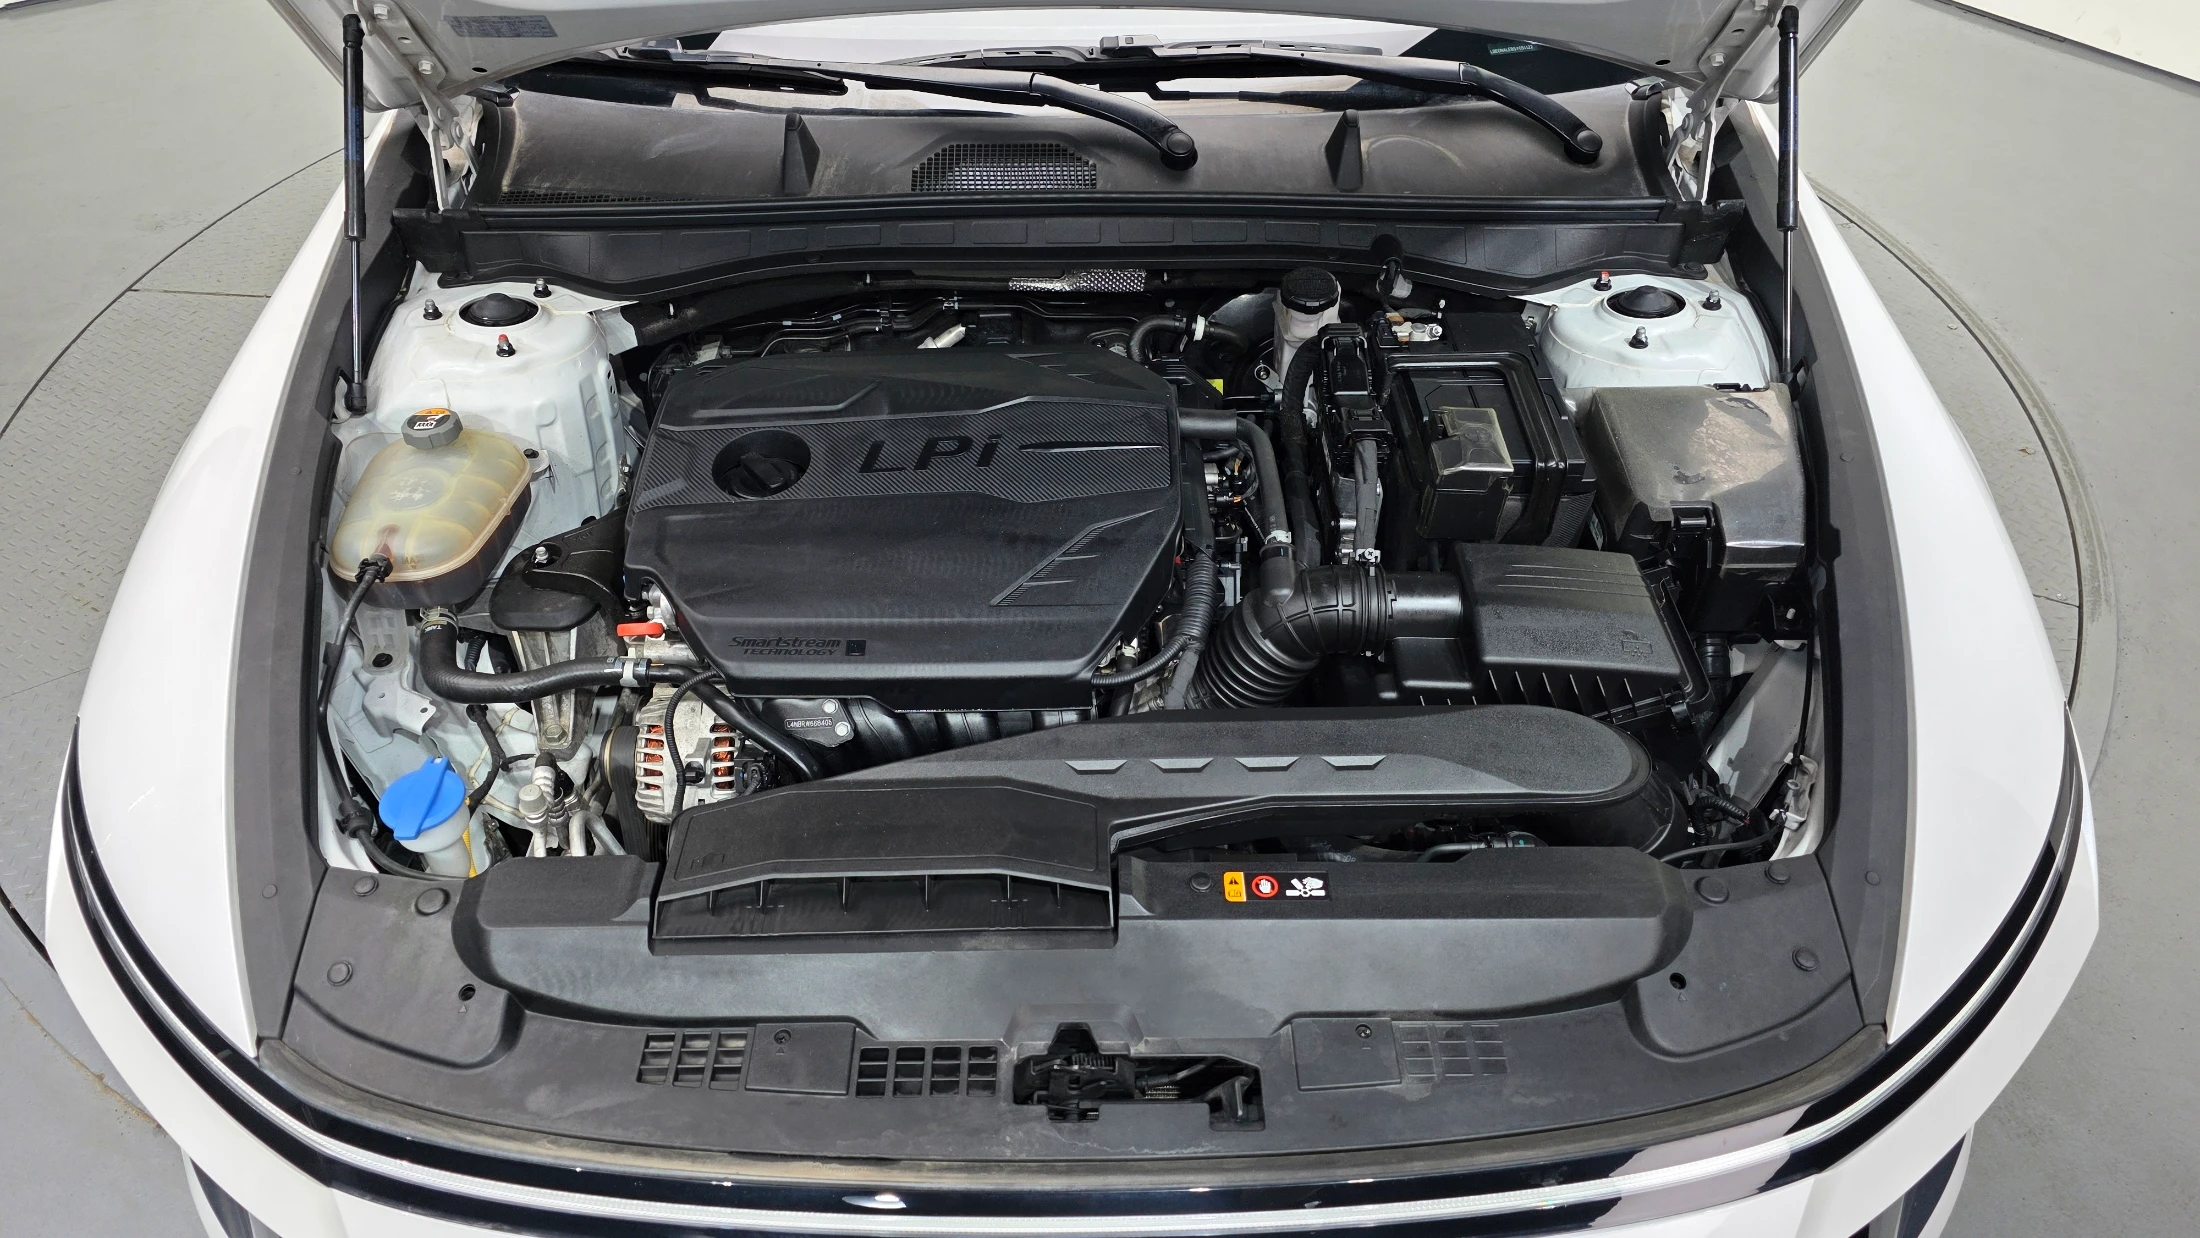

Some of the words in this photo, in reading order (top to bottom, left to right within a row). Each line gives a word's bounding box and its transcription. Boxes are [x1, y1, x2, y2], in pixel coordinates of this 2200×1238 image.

[858, 434, 1003, 474] LPi
[728, 636, 842, 648] Smartstream
[743, 648, 838, 656] TECHNOLOGY
